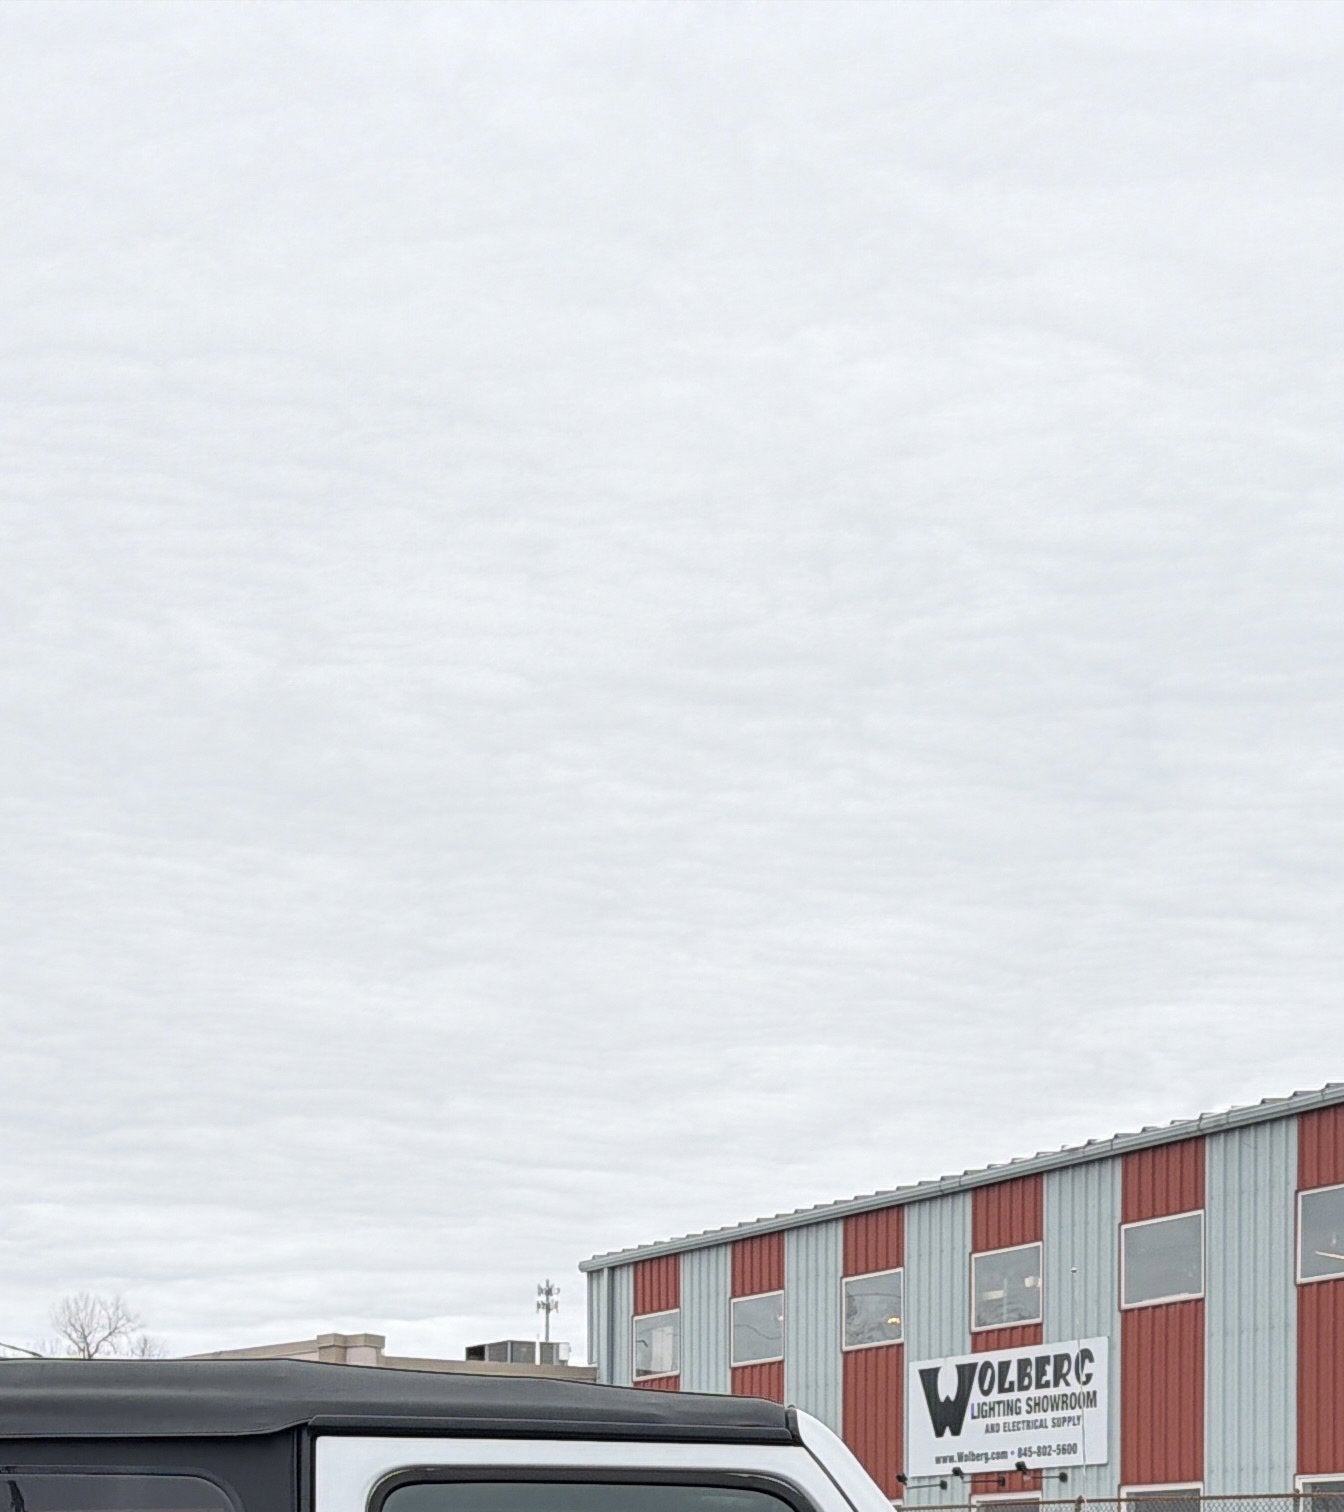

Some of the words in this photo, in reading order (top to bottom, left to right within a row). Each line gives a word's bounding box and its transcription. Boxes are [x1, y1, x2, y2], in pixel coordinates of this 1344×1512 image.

[918, 1347, 1095, 1438] WOLBERG
[970, 1398, 1022, 1420] LIGHTING
[1025, 1390, 1098, 1415] SHOWROOM
[984, 1422, 1001, 1434] AND
[1002, 1418, 1049, 1433] ELECTRICAL
[1051, 1414, 1082, 1429] SUPPLY
[935, 1450, 1008, 1465] www.Wolberg.com
[1017, 1443, 1078, 1459] 845-802-5600
